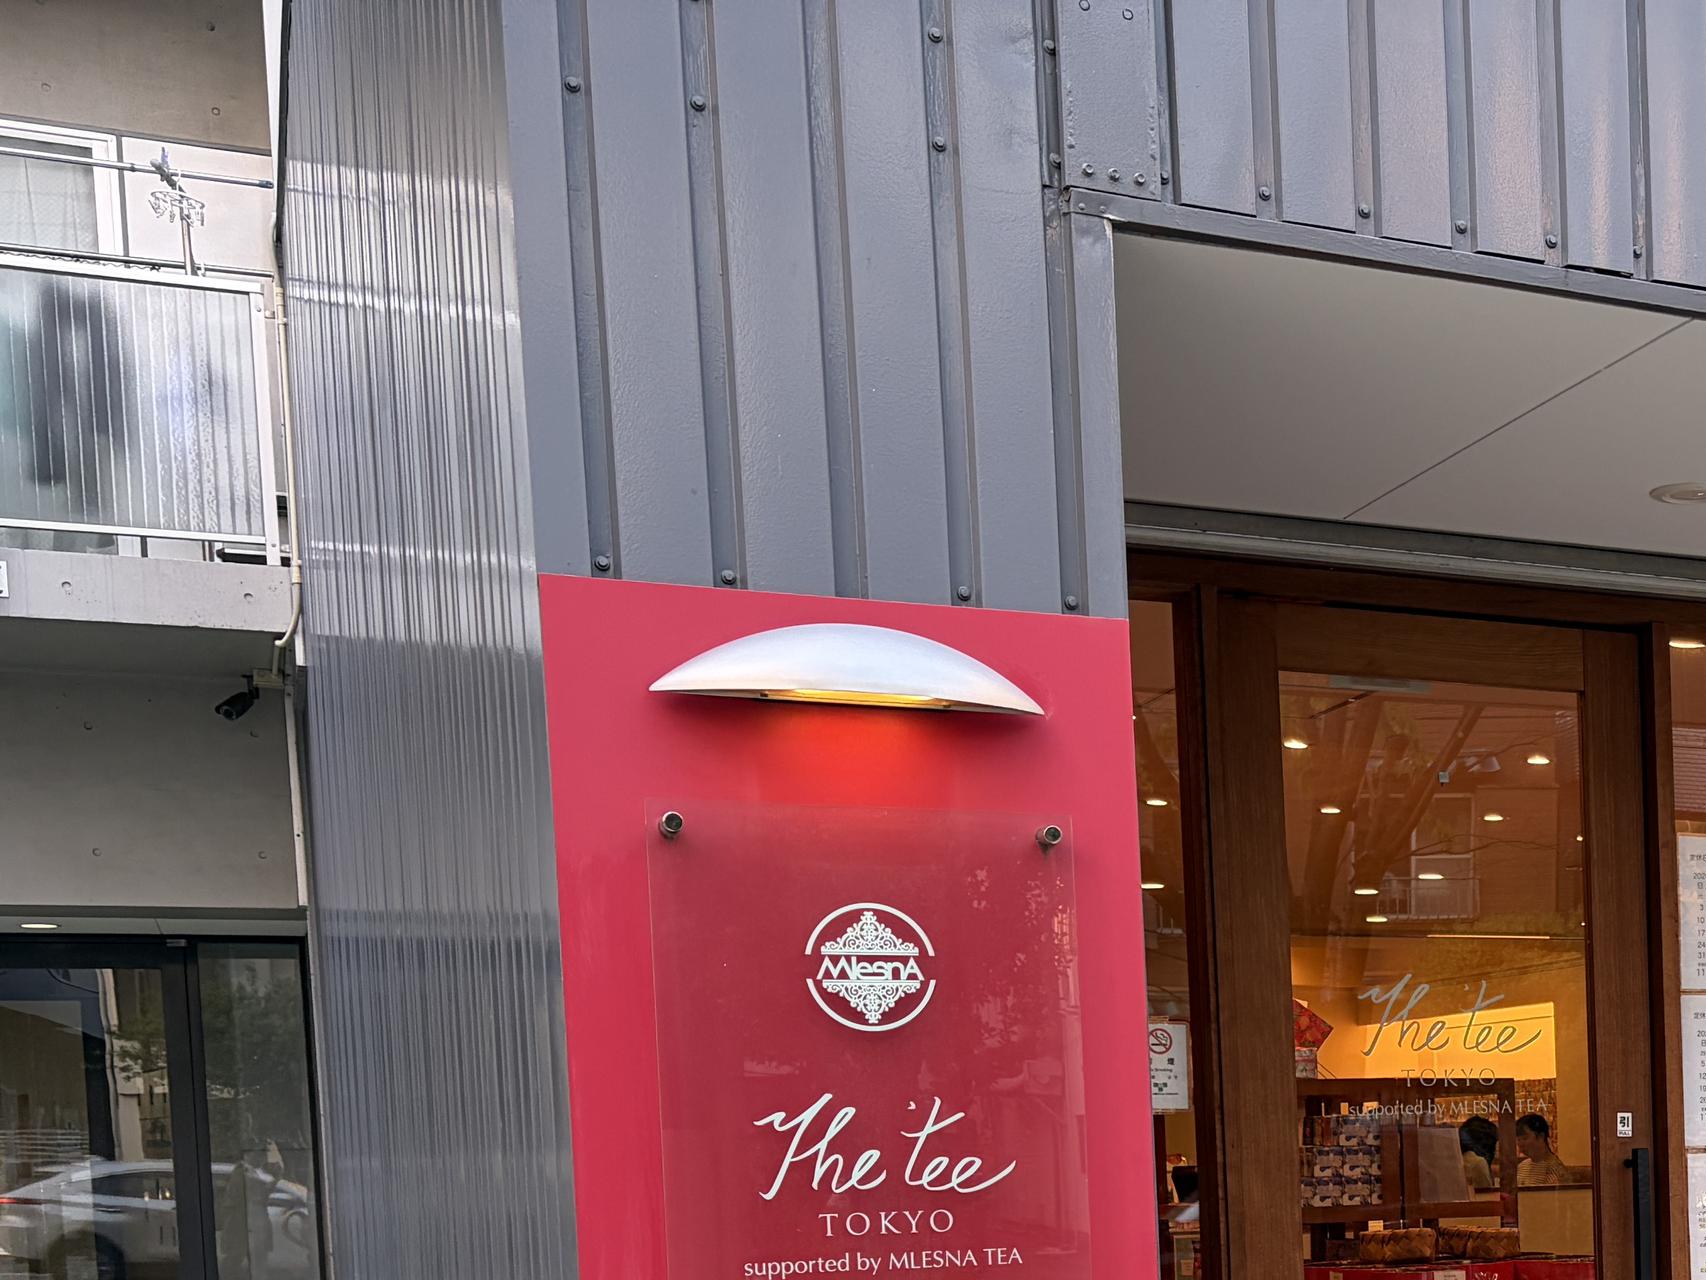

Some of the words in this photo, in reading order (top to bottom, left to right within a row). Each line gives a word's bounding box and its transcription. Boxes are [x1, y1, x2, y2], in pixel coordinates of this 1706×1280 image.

[1357, 973, 1450, 1057] The
[1400, 1067, 1498, 1089] TOKYO
[1348, 1099, 1424, 1118] supported
[1427, 1100, 1446, 1118] by
[1450, 1099, 1513, 1115] MLESNA
[1516, 1098, 1548, 1112] TEA
[1619, 1116, 1630, 1128] 引
[753, 1093, 887, 1203] The
[818, 1208, 956, 1238] TOKYO
[743, 1253, 853, 1279] supported
[857, 1251, 883, 1277] by
[888, 1248, 978, 1271] MLESNA
[982, 1246, 1023, 1267] TEA
